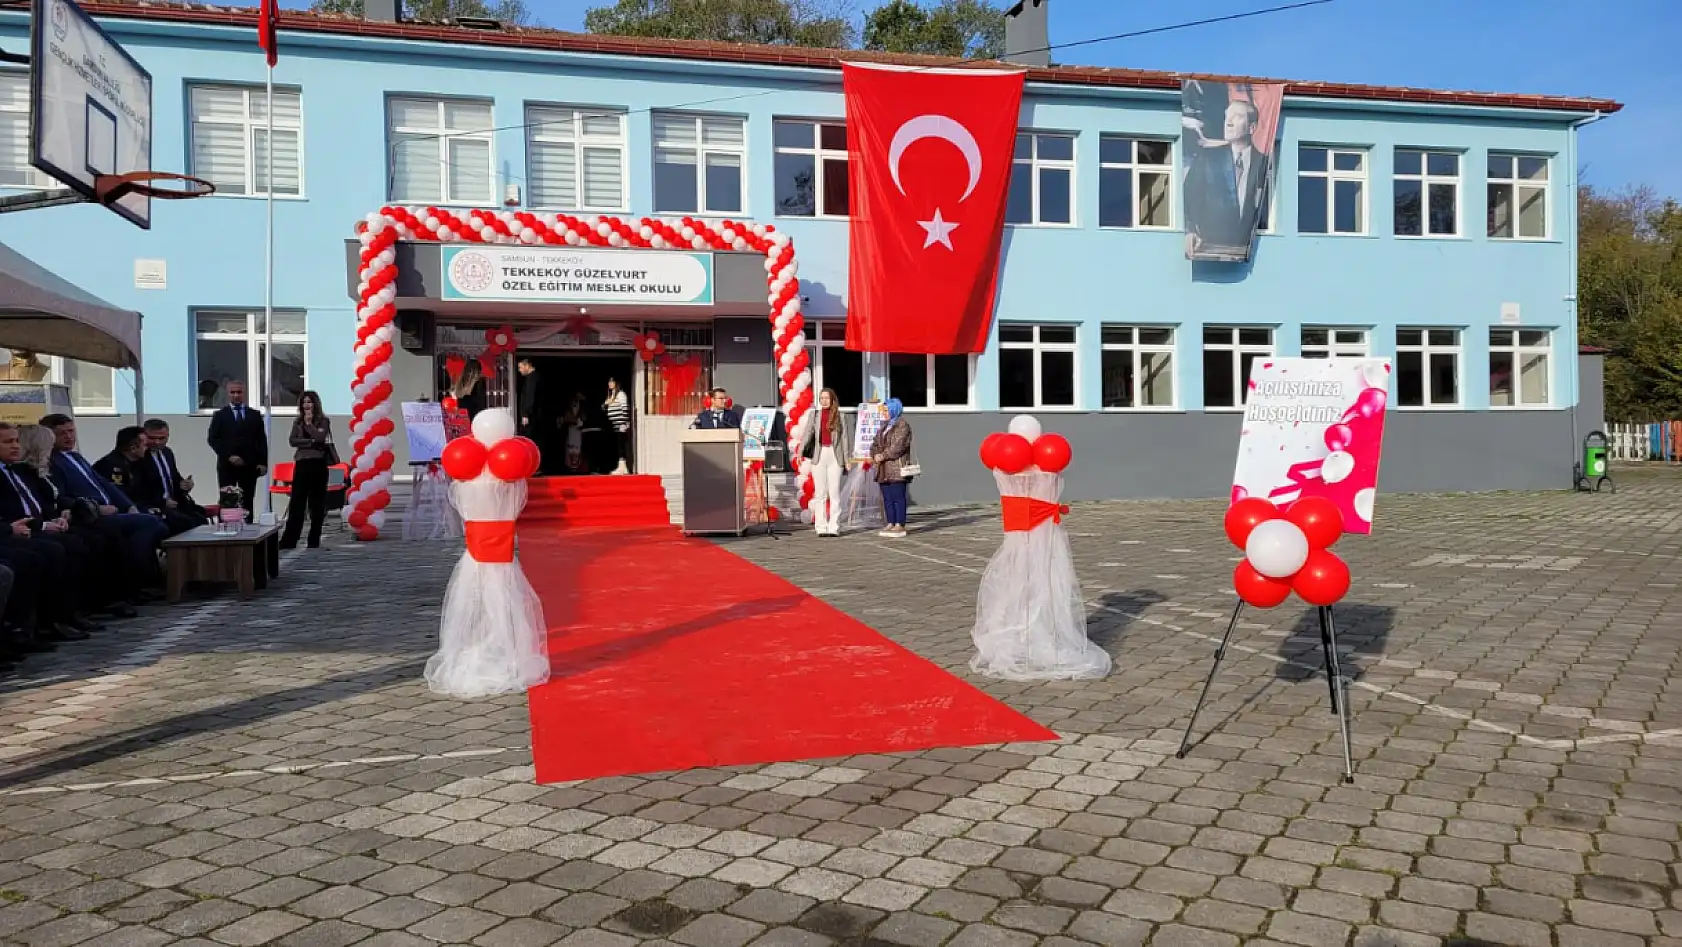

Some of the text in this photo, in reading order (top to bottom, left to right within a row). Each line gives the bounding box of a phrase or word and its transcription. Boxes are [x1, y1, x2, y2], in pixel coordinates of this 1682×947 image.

[574, 268, 648, 279] GÜZELYURT
[502, 280, 682, 294] ÖZEL EĞİTİM MESLEK OKULU
